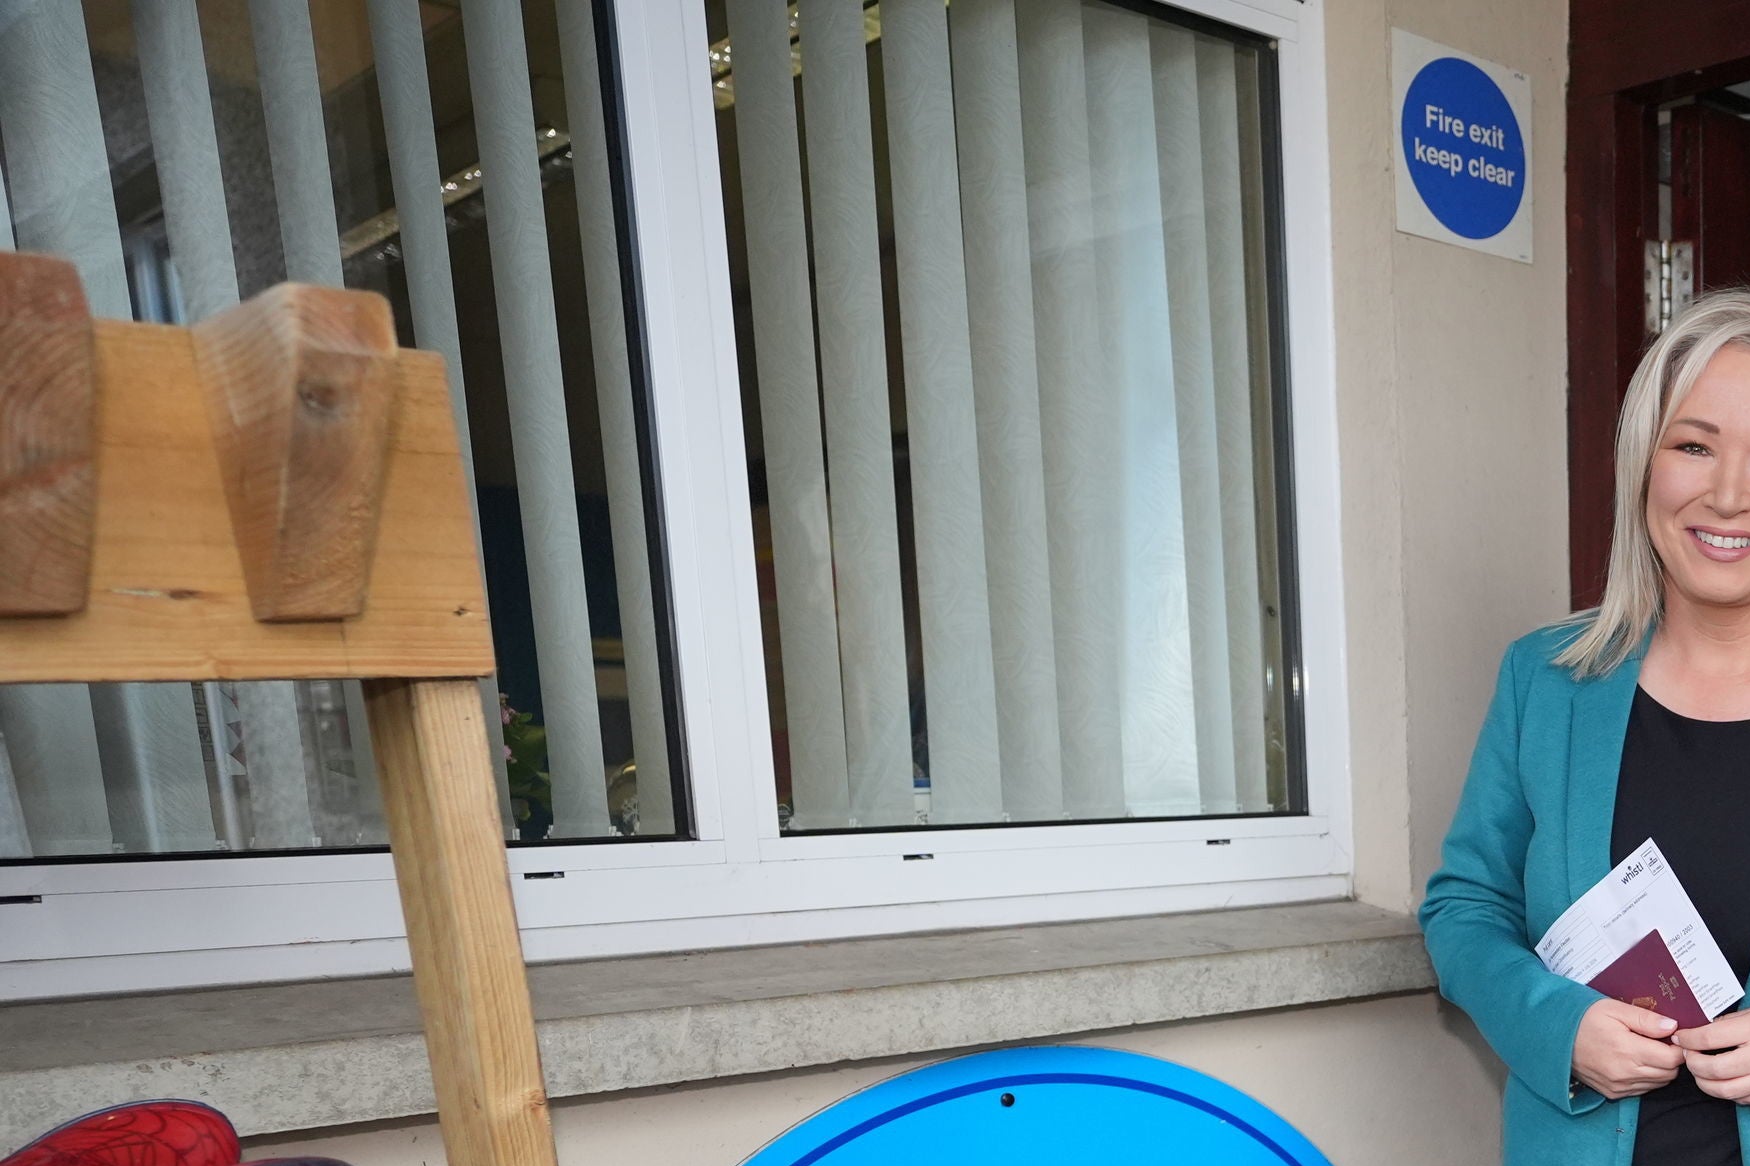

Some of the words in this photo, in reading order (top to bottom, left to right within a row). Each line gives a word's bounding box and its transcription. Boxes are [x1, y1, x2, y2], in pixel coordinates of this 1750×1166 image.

[1425, 104, 1464, 138] Fire
[1469, 124, 1504, 150] exit
[1414, 137, 1463, 177] keep
[1468, 156, 1515, 187] clear
[1621, 862, 1644, 885] whistl
